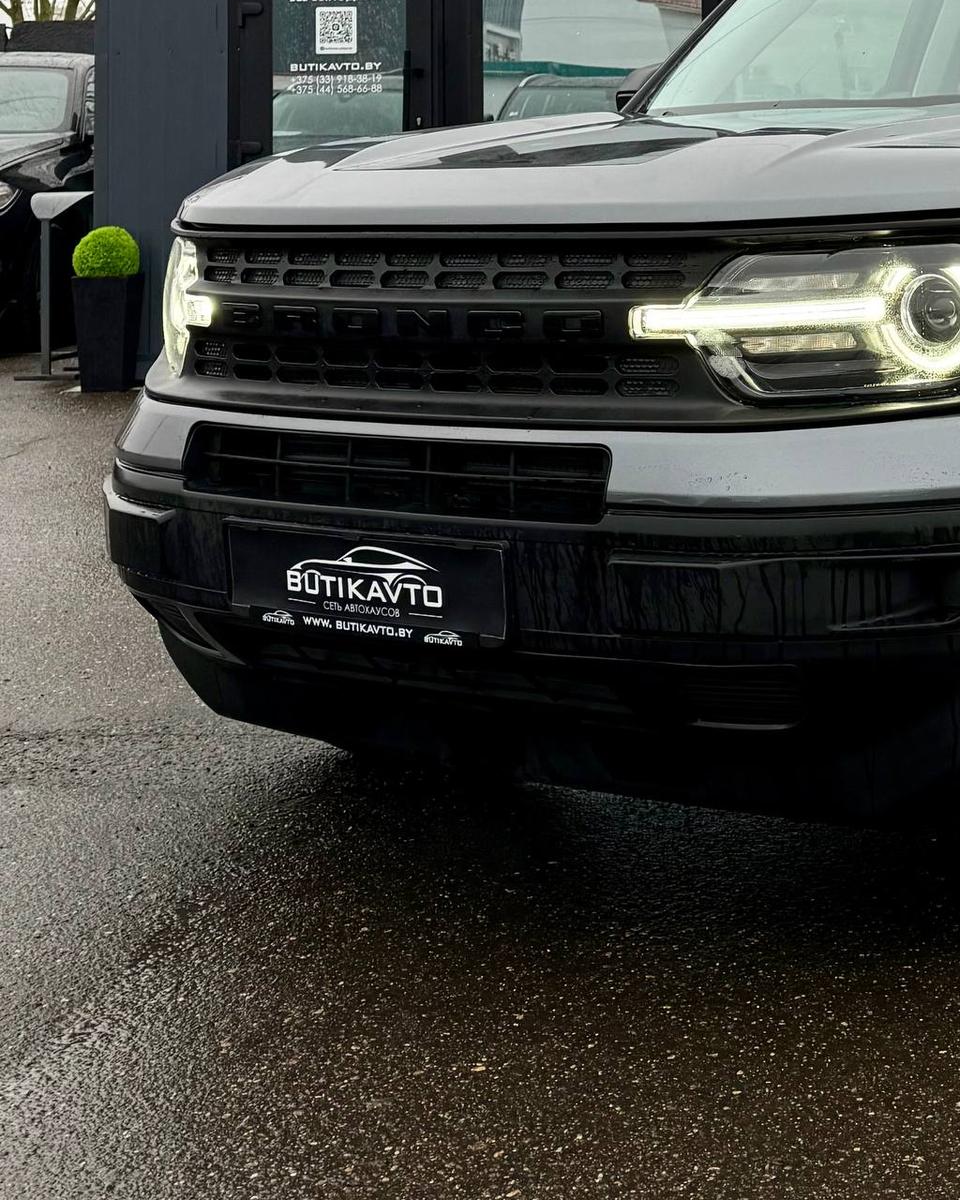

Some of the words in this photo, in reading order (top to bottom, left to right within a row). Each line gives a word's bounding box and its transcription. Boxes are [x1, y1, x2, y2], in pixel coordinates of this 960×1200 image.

[290, 62, 382, 72] BUTIKAVTO.BY
[336, 84, 382, 94] 568-66-88
[220, 302, 604, 341] BRONCO
[286, 569, 443, 608] BUTIKAVTO
[323, 600, 343, 611] СЕТЬ
[344, 603, 400, 618] АВТОХАУСОВ
